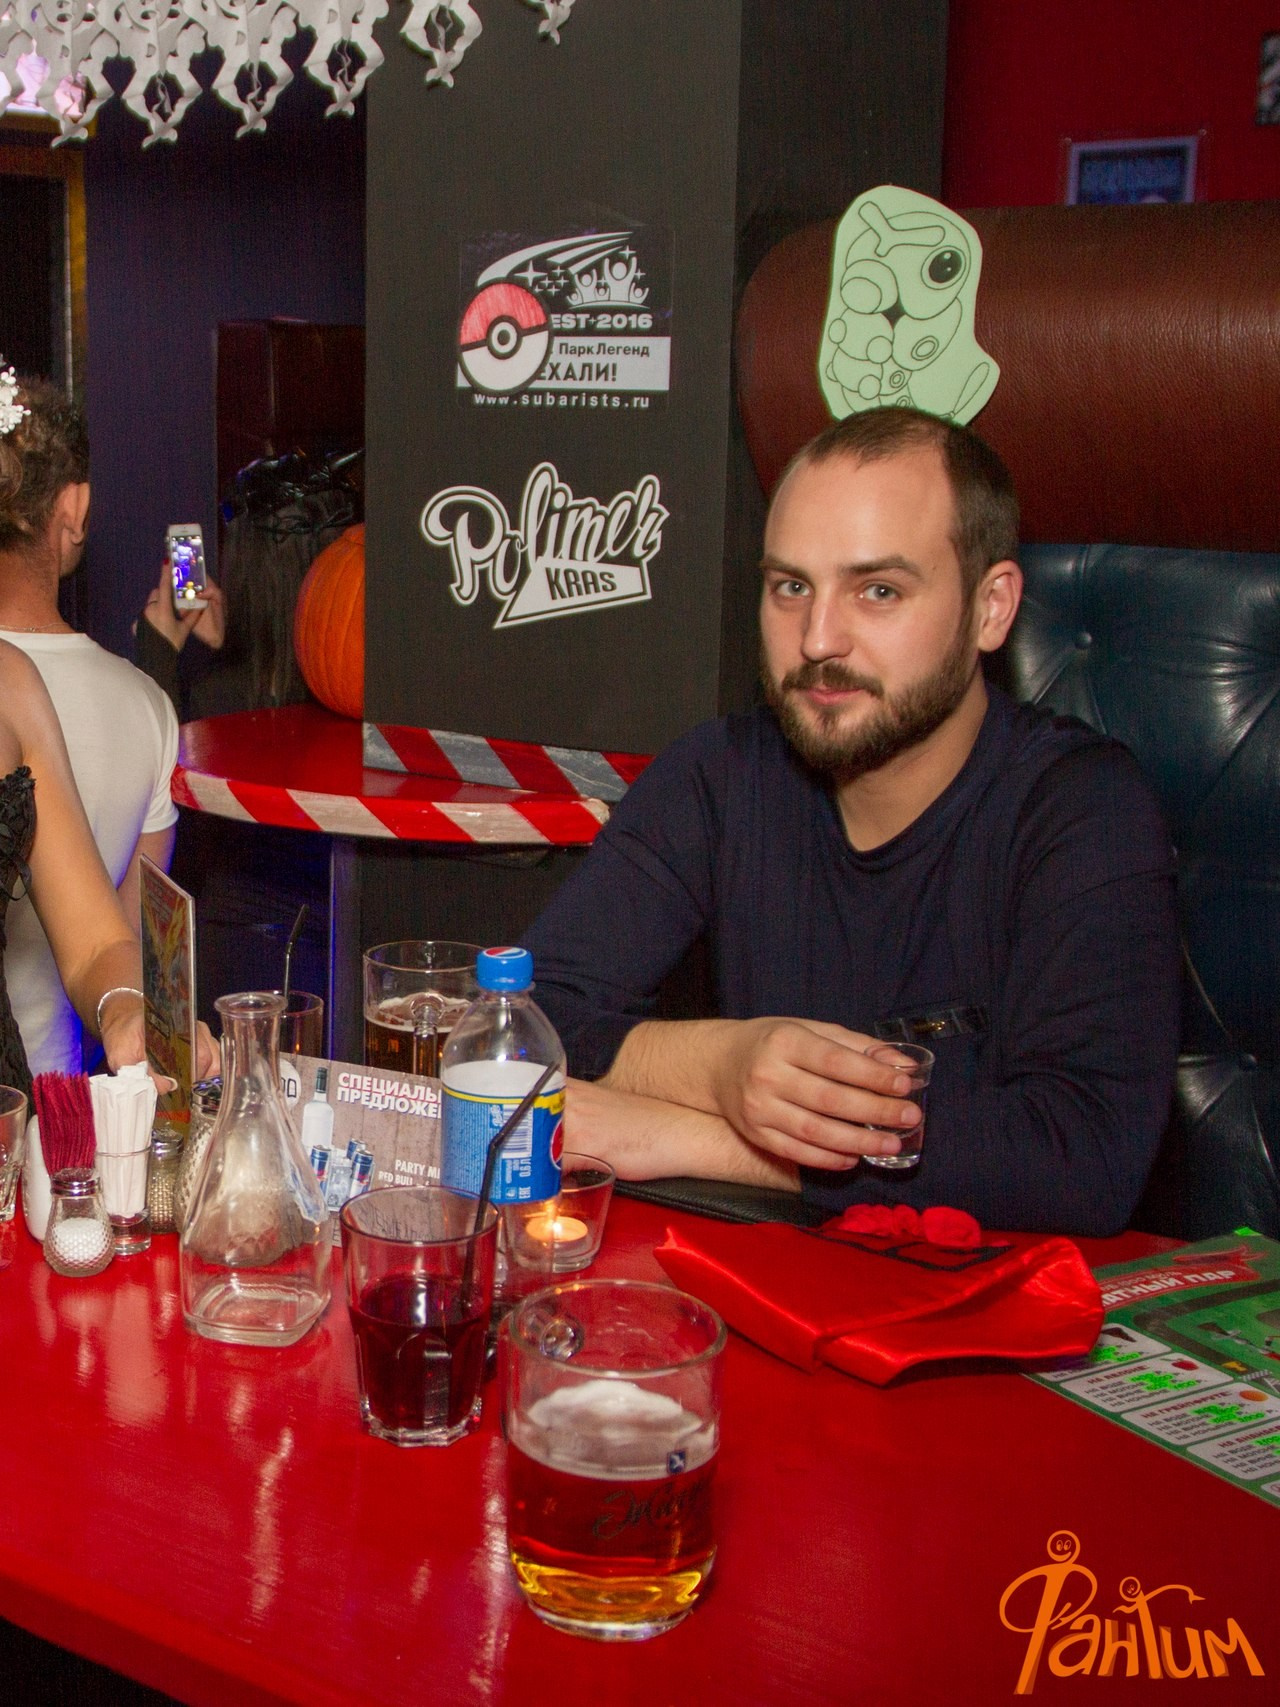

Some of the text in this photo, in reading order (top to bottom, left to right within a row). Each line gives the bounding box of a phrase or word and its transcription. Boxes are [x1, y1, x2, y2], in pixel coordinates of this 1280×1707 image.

[596, 313, 653, 329] 2016
[558, 342, 650, 358] Парк Легенд
[473, 392, 650, 408] www.subarists.ru
[545, 567, 618, 600] KRAS
[395, 1159, 426, 1177] PARTY
[378, 1171, 394, 1183] RED
